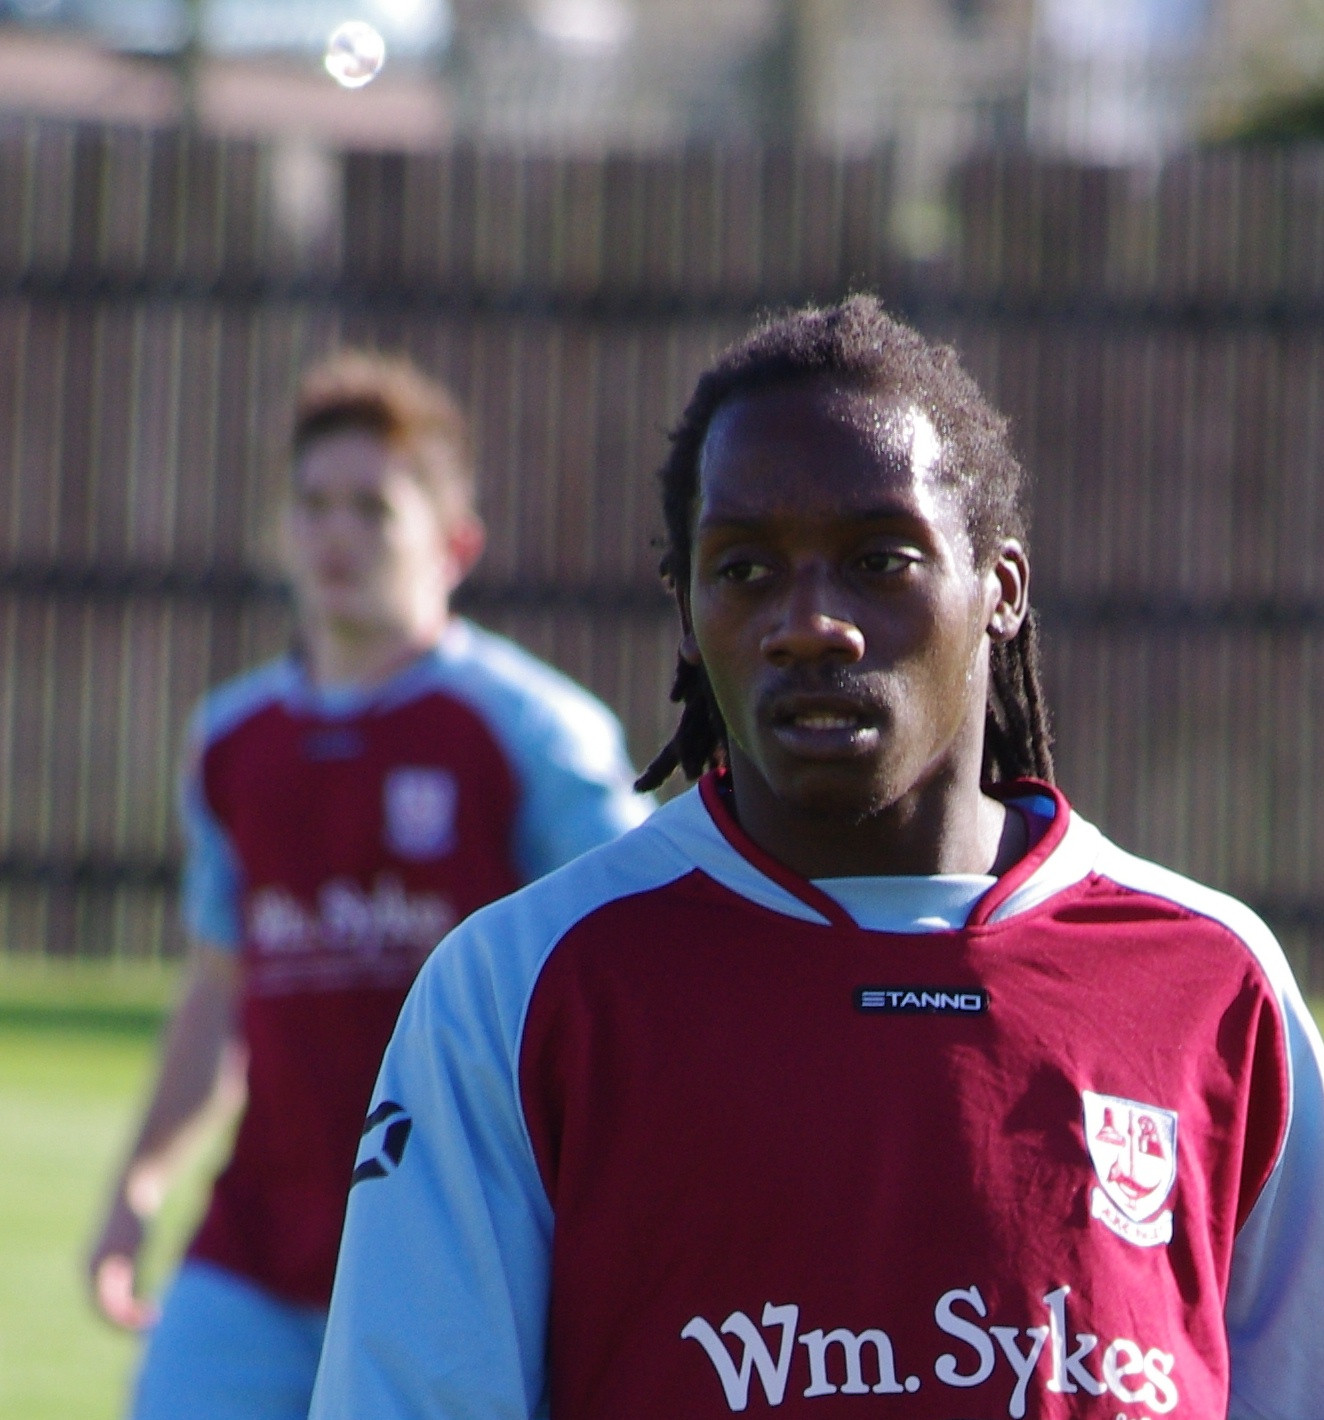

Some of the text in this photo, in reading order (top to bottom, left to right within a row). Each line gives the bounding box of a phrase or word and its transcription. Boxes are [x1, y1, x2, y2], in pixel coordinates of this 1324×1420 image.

[861, 990, 982, 1011] STANNO
[681, 1285, 1179, 1420] Wm. Sykes
